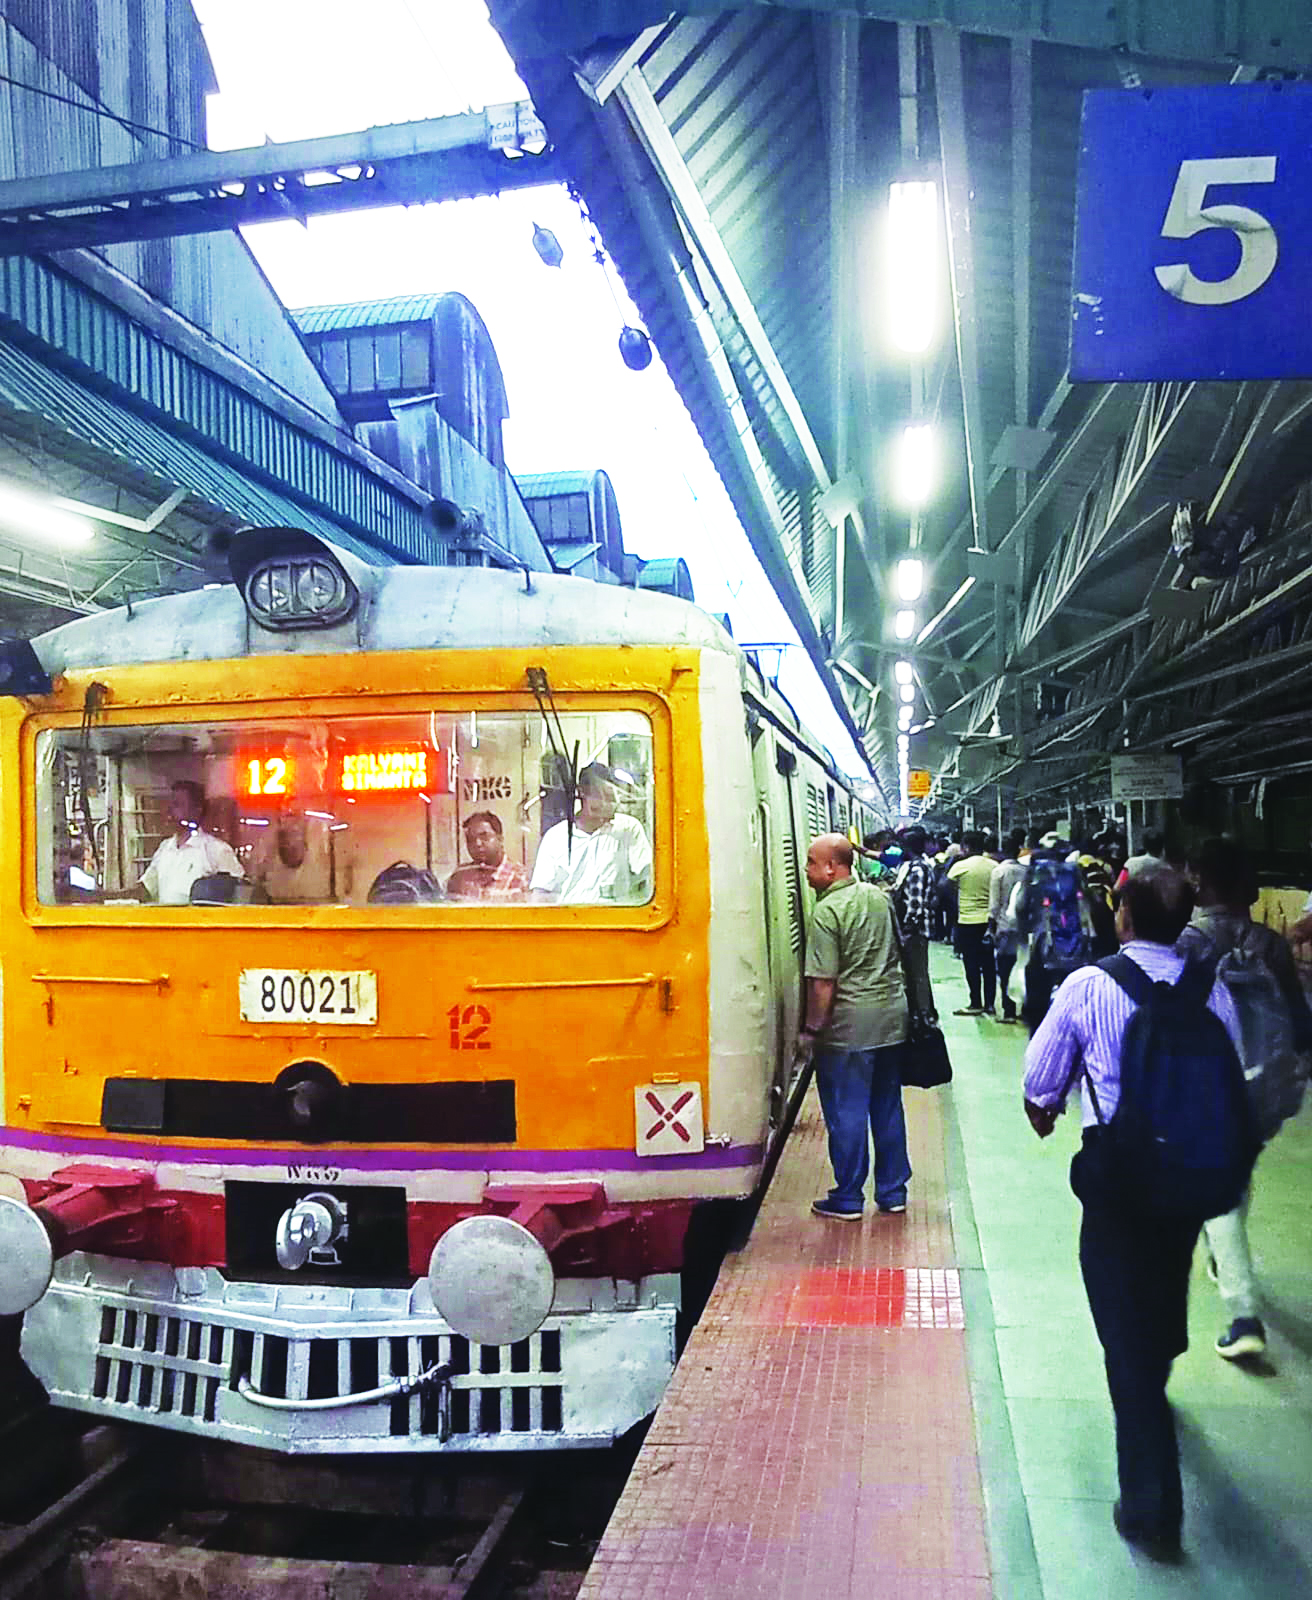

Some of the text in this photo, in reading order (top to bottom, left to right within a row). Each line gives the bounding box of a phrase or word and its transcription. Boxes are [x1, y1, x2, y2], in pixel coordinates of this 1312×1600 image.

[1154, 156, 1278, 305] 5
[248, 758, 286, 794] 12
[343, 752, 426, 772] KALYANI
[261, 976, 357, 1014] 80021
[446, 1004, 491, 1050] 12
